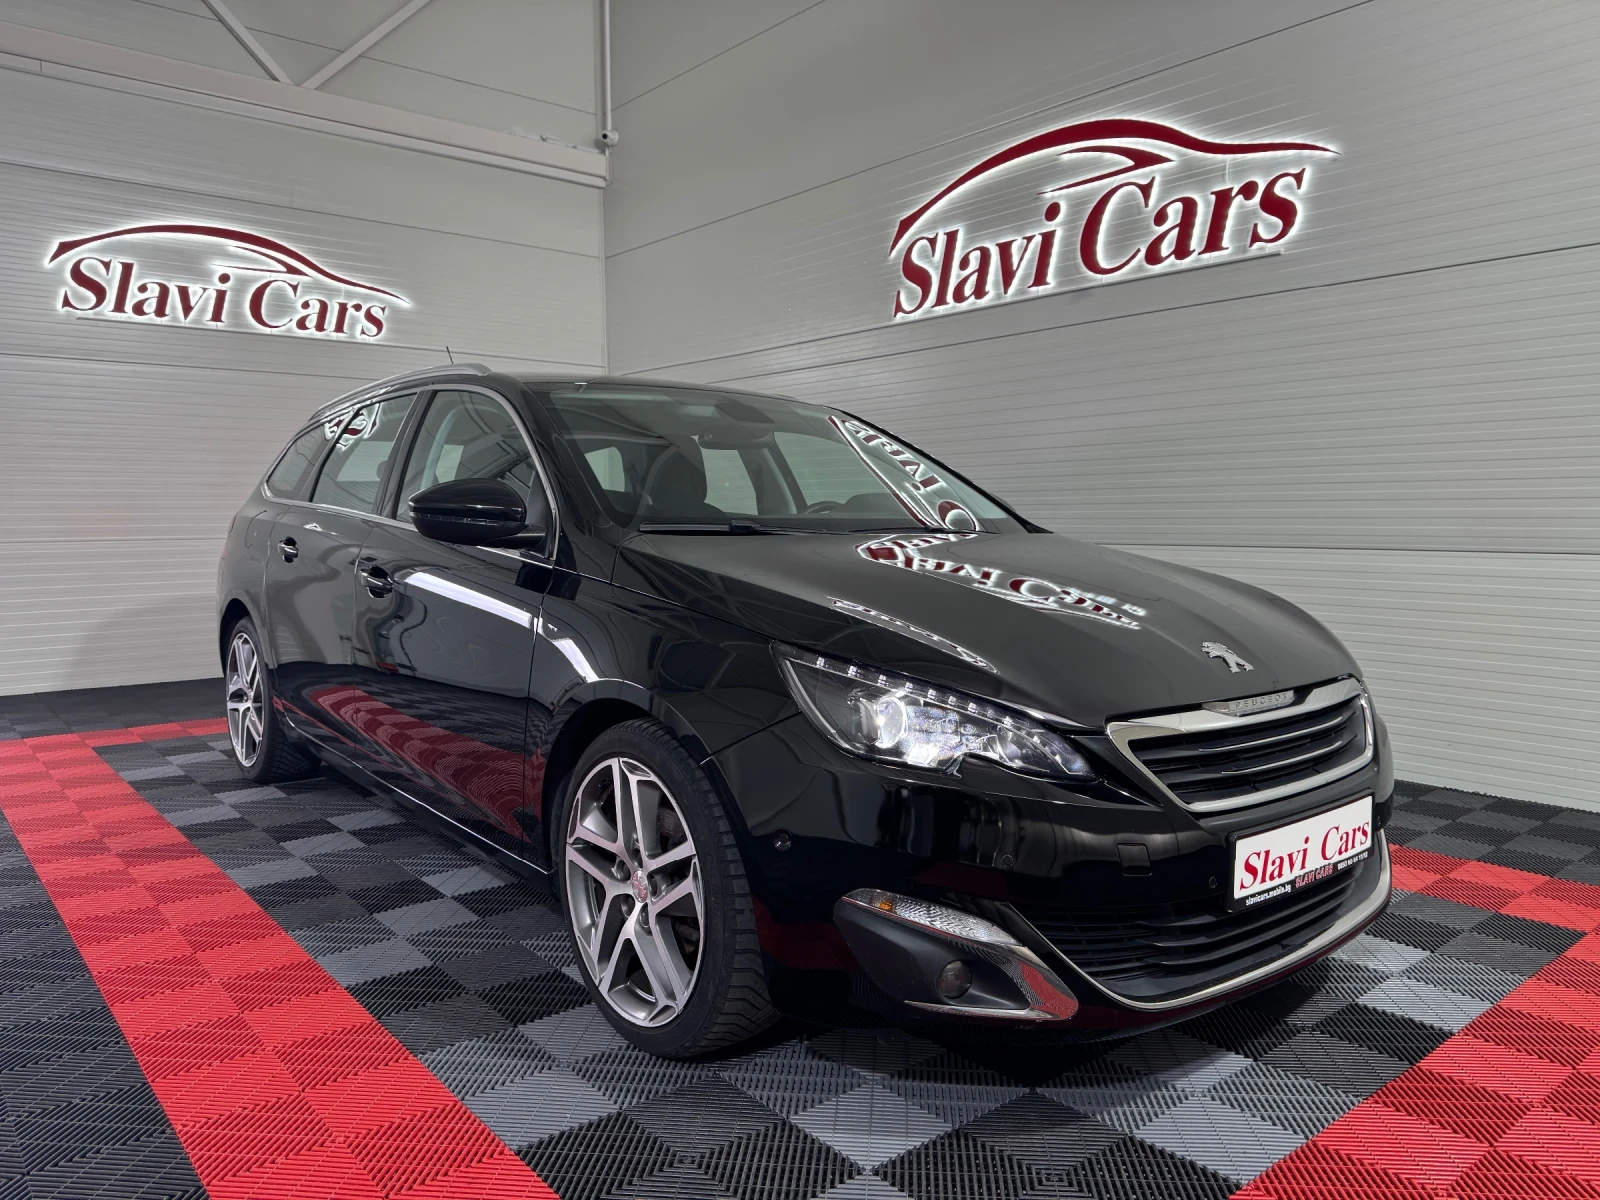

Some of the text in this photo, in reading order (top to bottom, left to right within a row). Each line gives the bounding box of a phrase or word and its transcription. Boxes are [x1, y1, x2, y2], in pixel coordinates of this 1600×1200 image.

[893, 168, 1307, 318] Slavi Cars
[61, 256, 387, 338] Slavi Cars
[1235, 692, 1288, 709] PEUGEOT
[1239, 821, 1370, 891] Slavi Cars
[1295, 863, 1334, 888] SLAVI CARS
[1245, 883, 1292, 906] slavicars.mobile.bg
